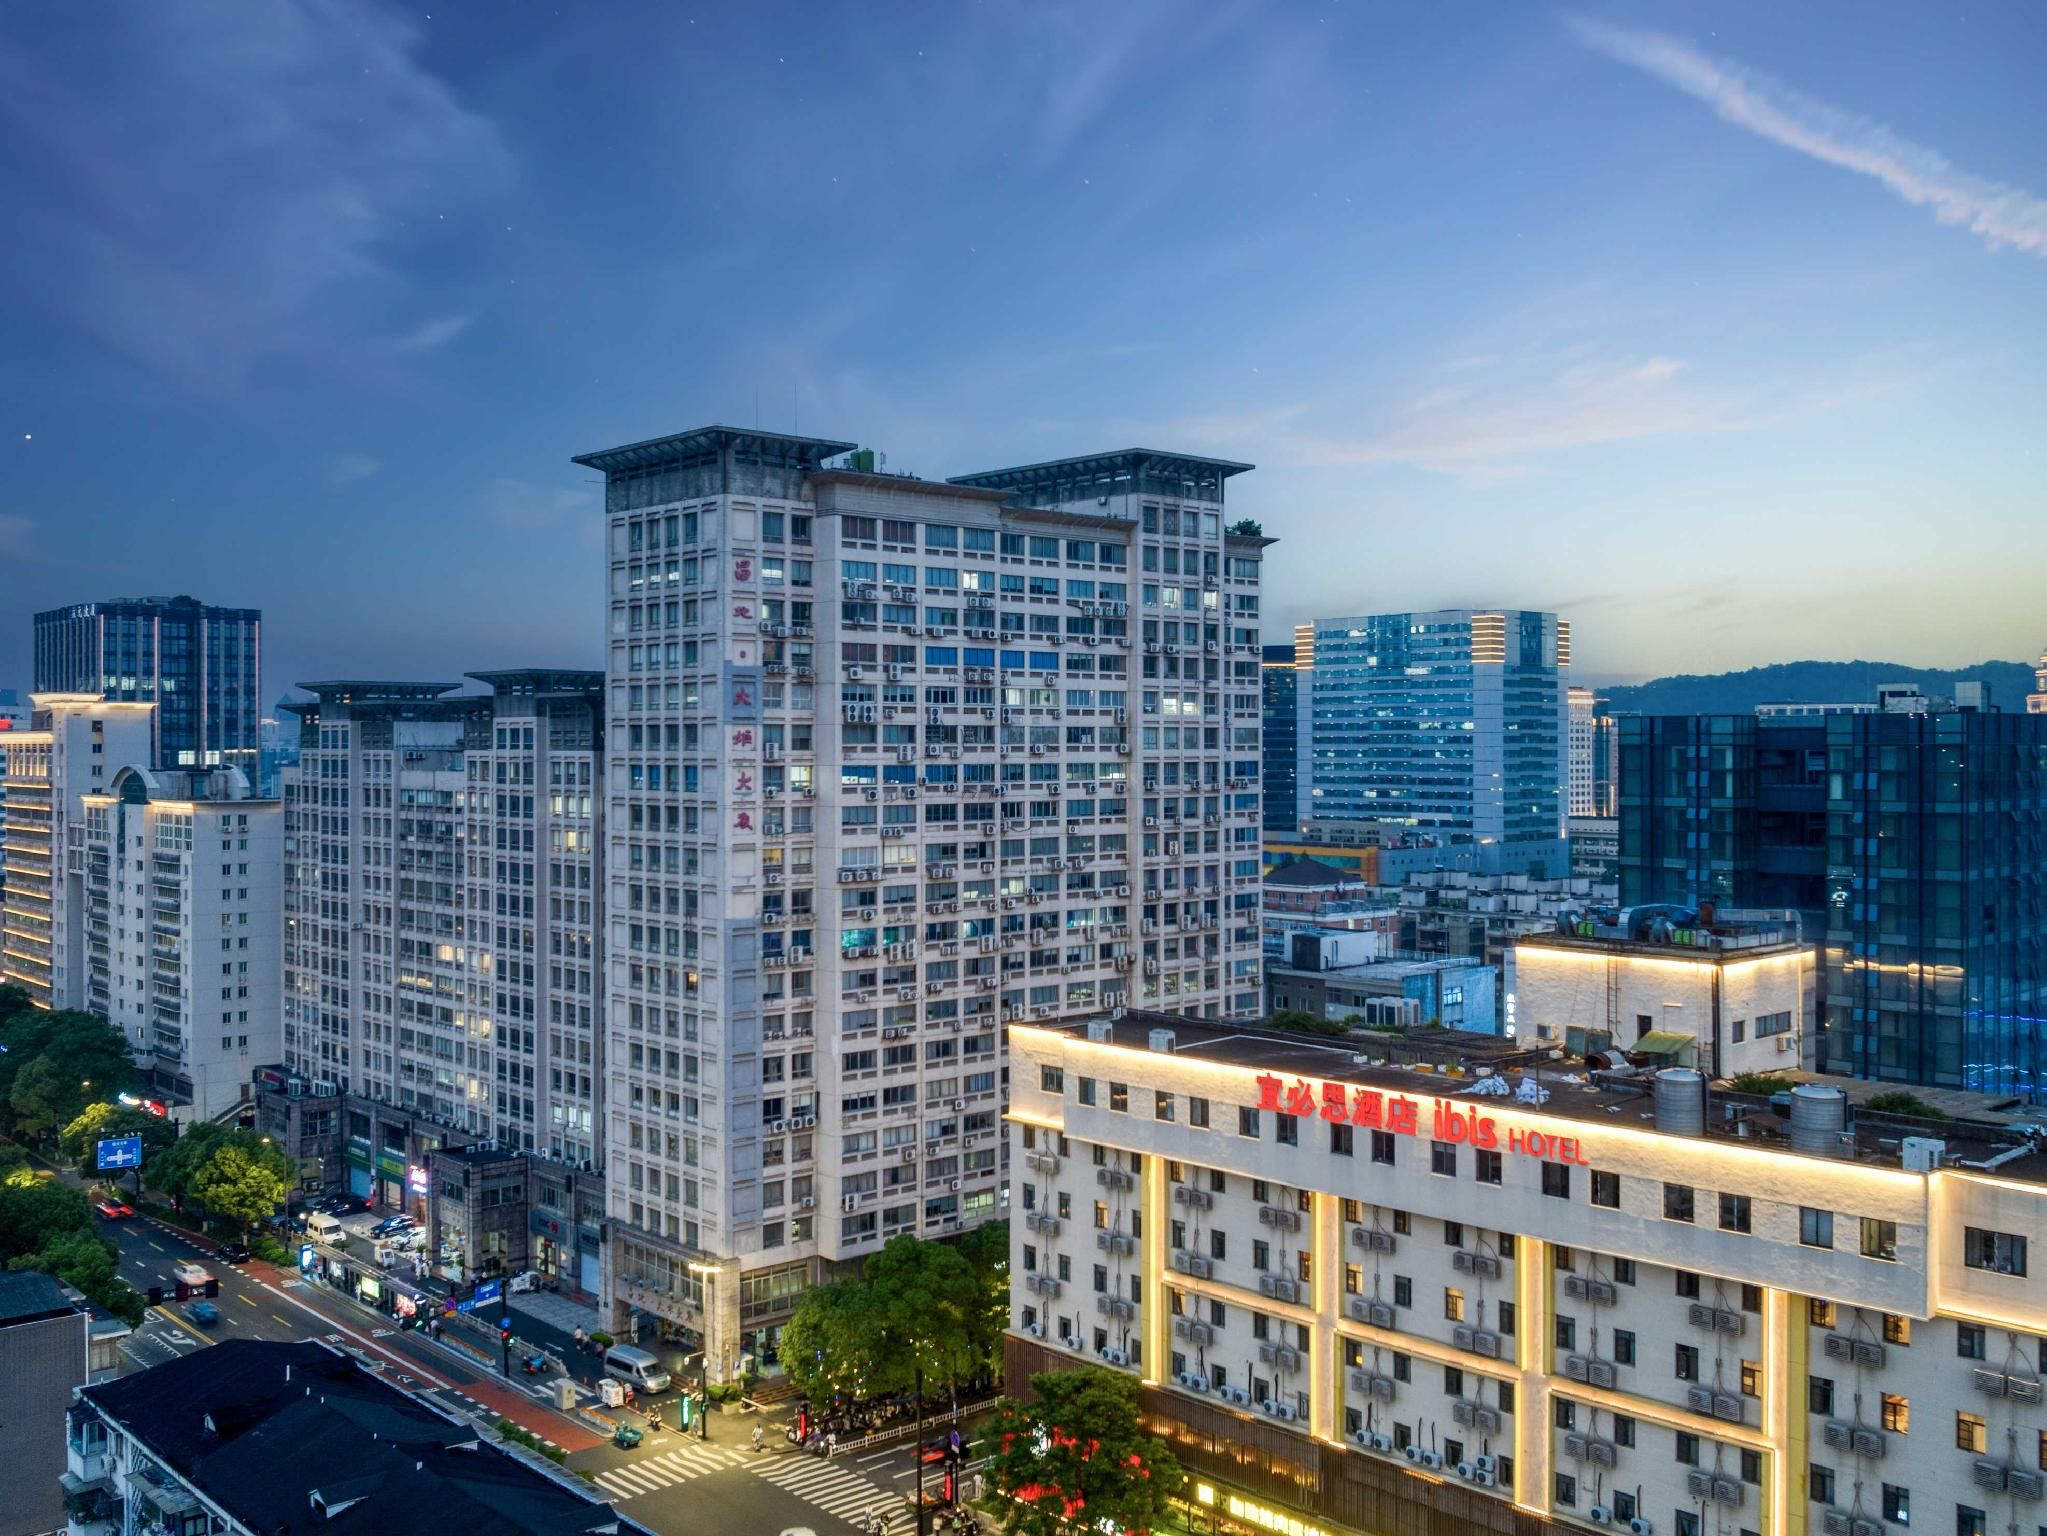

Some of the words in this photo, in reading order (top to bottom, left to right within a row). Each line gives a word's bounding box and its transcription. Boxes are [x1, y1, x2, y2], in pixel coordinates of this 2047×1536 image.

[1256, 1073, 1418, 1136] 宜必思酒店
[1434, 1097, 1498, 1149] ibis
[1508, 1127, 1590, 1166] HOTEL
